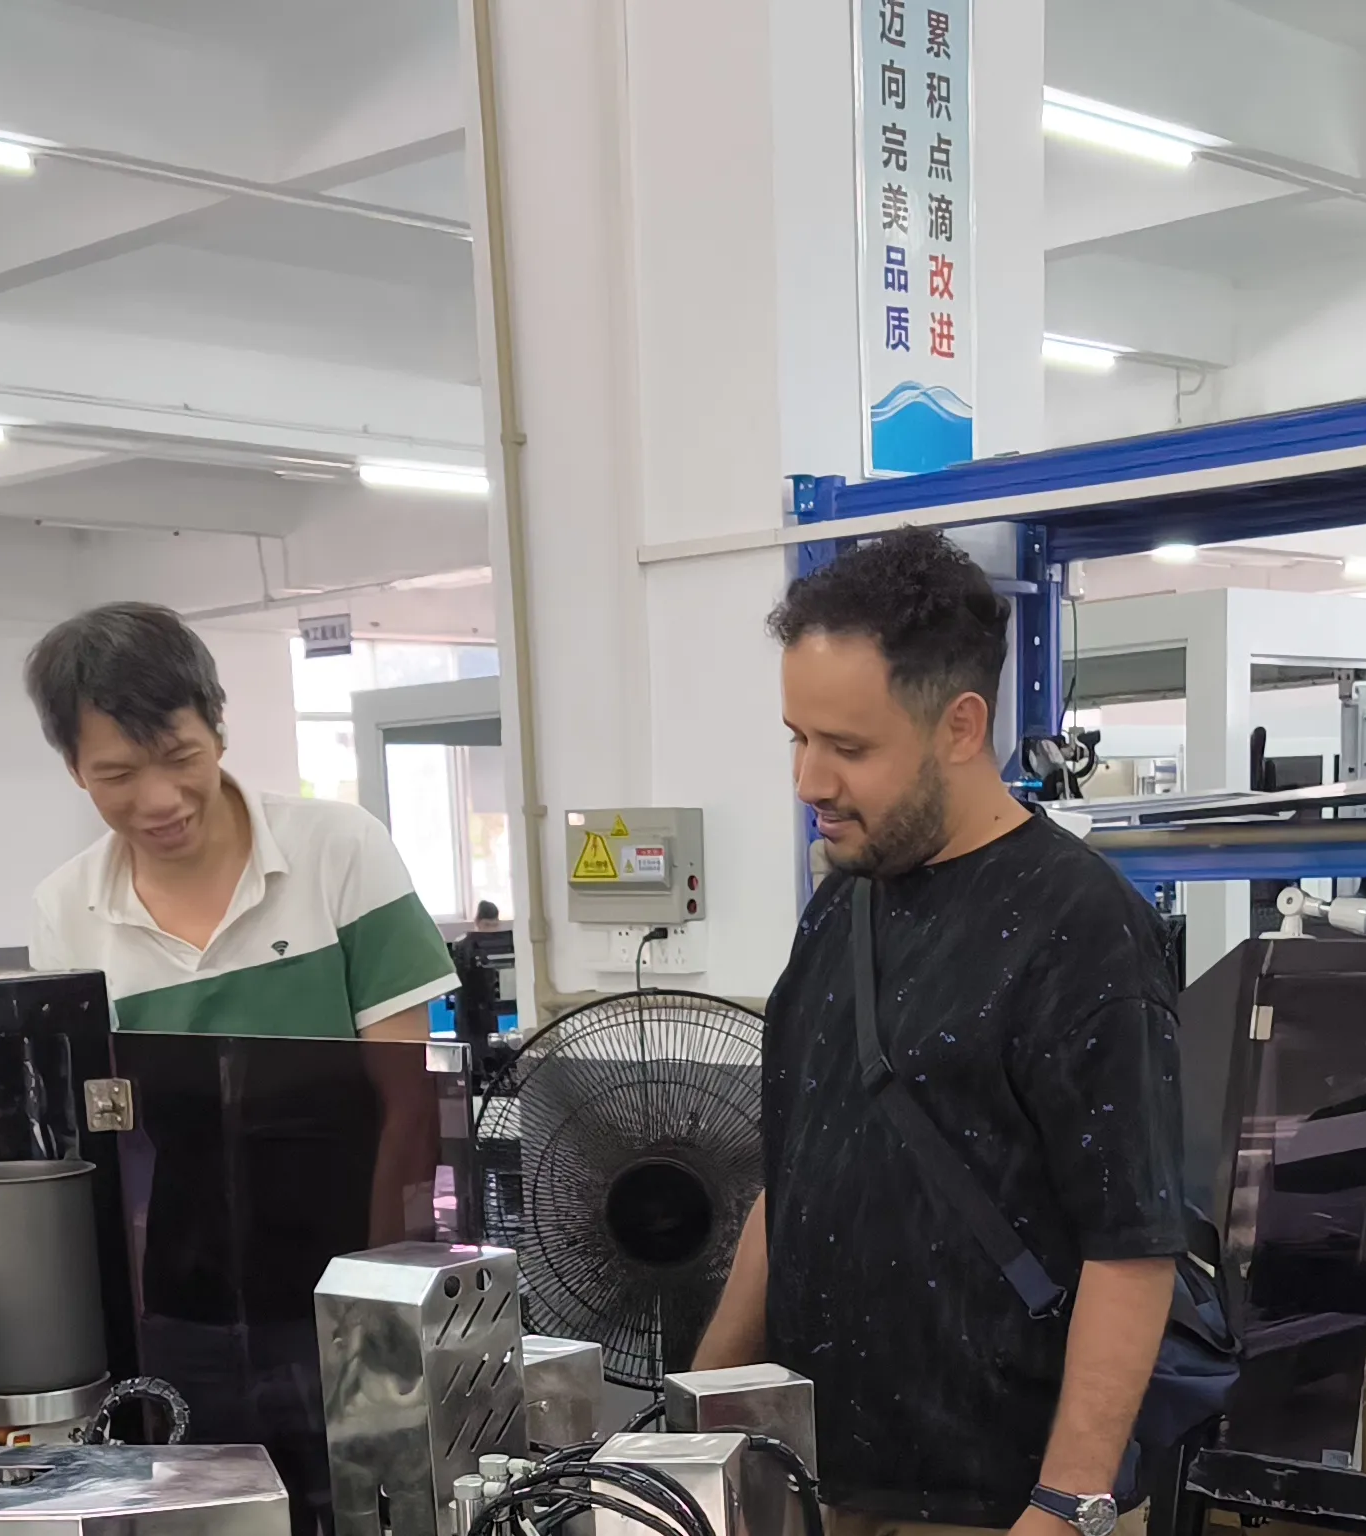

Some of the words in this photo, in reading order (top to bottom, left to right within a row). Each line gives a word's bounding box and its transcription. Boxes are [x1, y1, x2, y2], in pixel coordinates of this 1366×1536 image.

[878, 0, 910, 353] 迈向完美品质
[925, 8, 955, 359] 累积点滴改进
